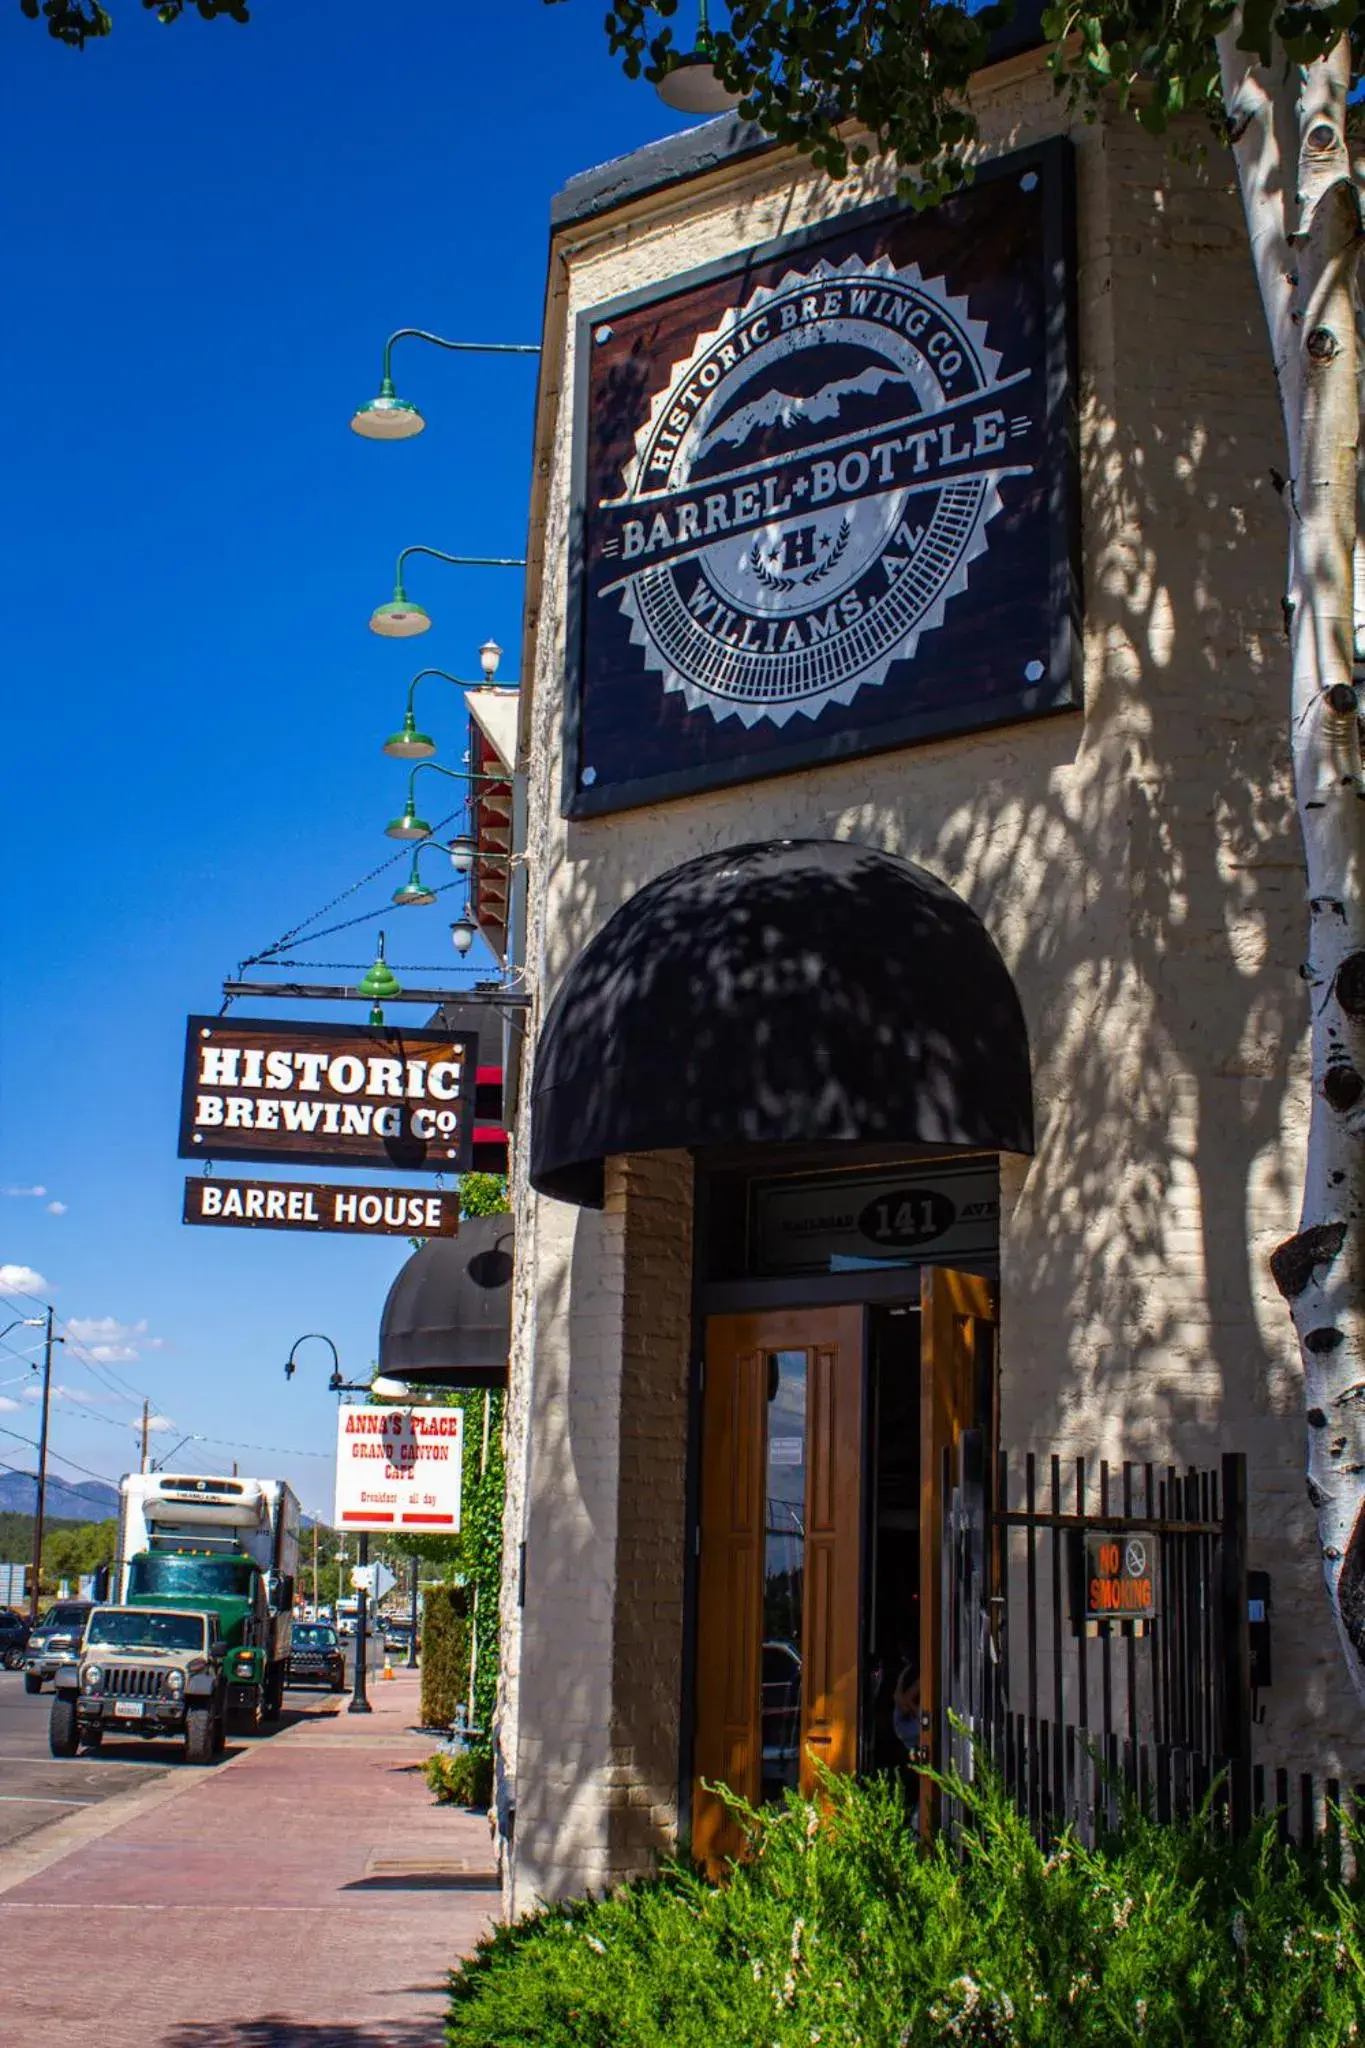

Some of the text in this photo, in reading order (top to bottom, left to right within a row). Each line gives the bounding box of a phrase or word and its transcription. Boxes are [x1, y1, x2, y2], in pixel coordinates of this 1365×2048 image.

[650, 288, 963, 473] HISTORIC BREWING CO.
[881, 520, 925, 584] AZ
[199, 1046, 461, 1100] HISTORIC
[195, 1095, 401, 1138] BREWING
[201, 1186, 442, 1228] BARREL HOUSE
[876, 1200, 936, 1238] 141
[345, 1415, 458, 1436] ANNA'S PLACE
[352, 1443, 449, 1460] GRAND CANYON
[385, 1465, 415, 1480] CAFE
[1099, 1544, 1119, 1574] NO
[1090, 1578, 1152, 1610] SMOKING
